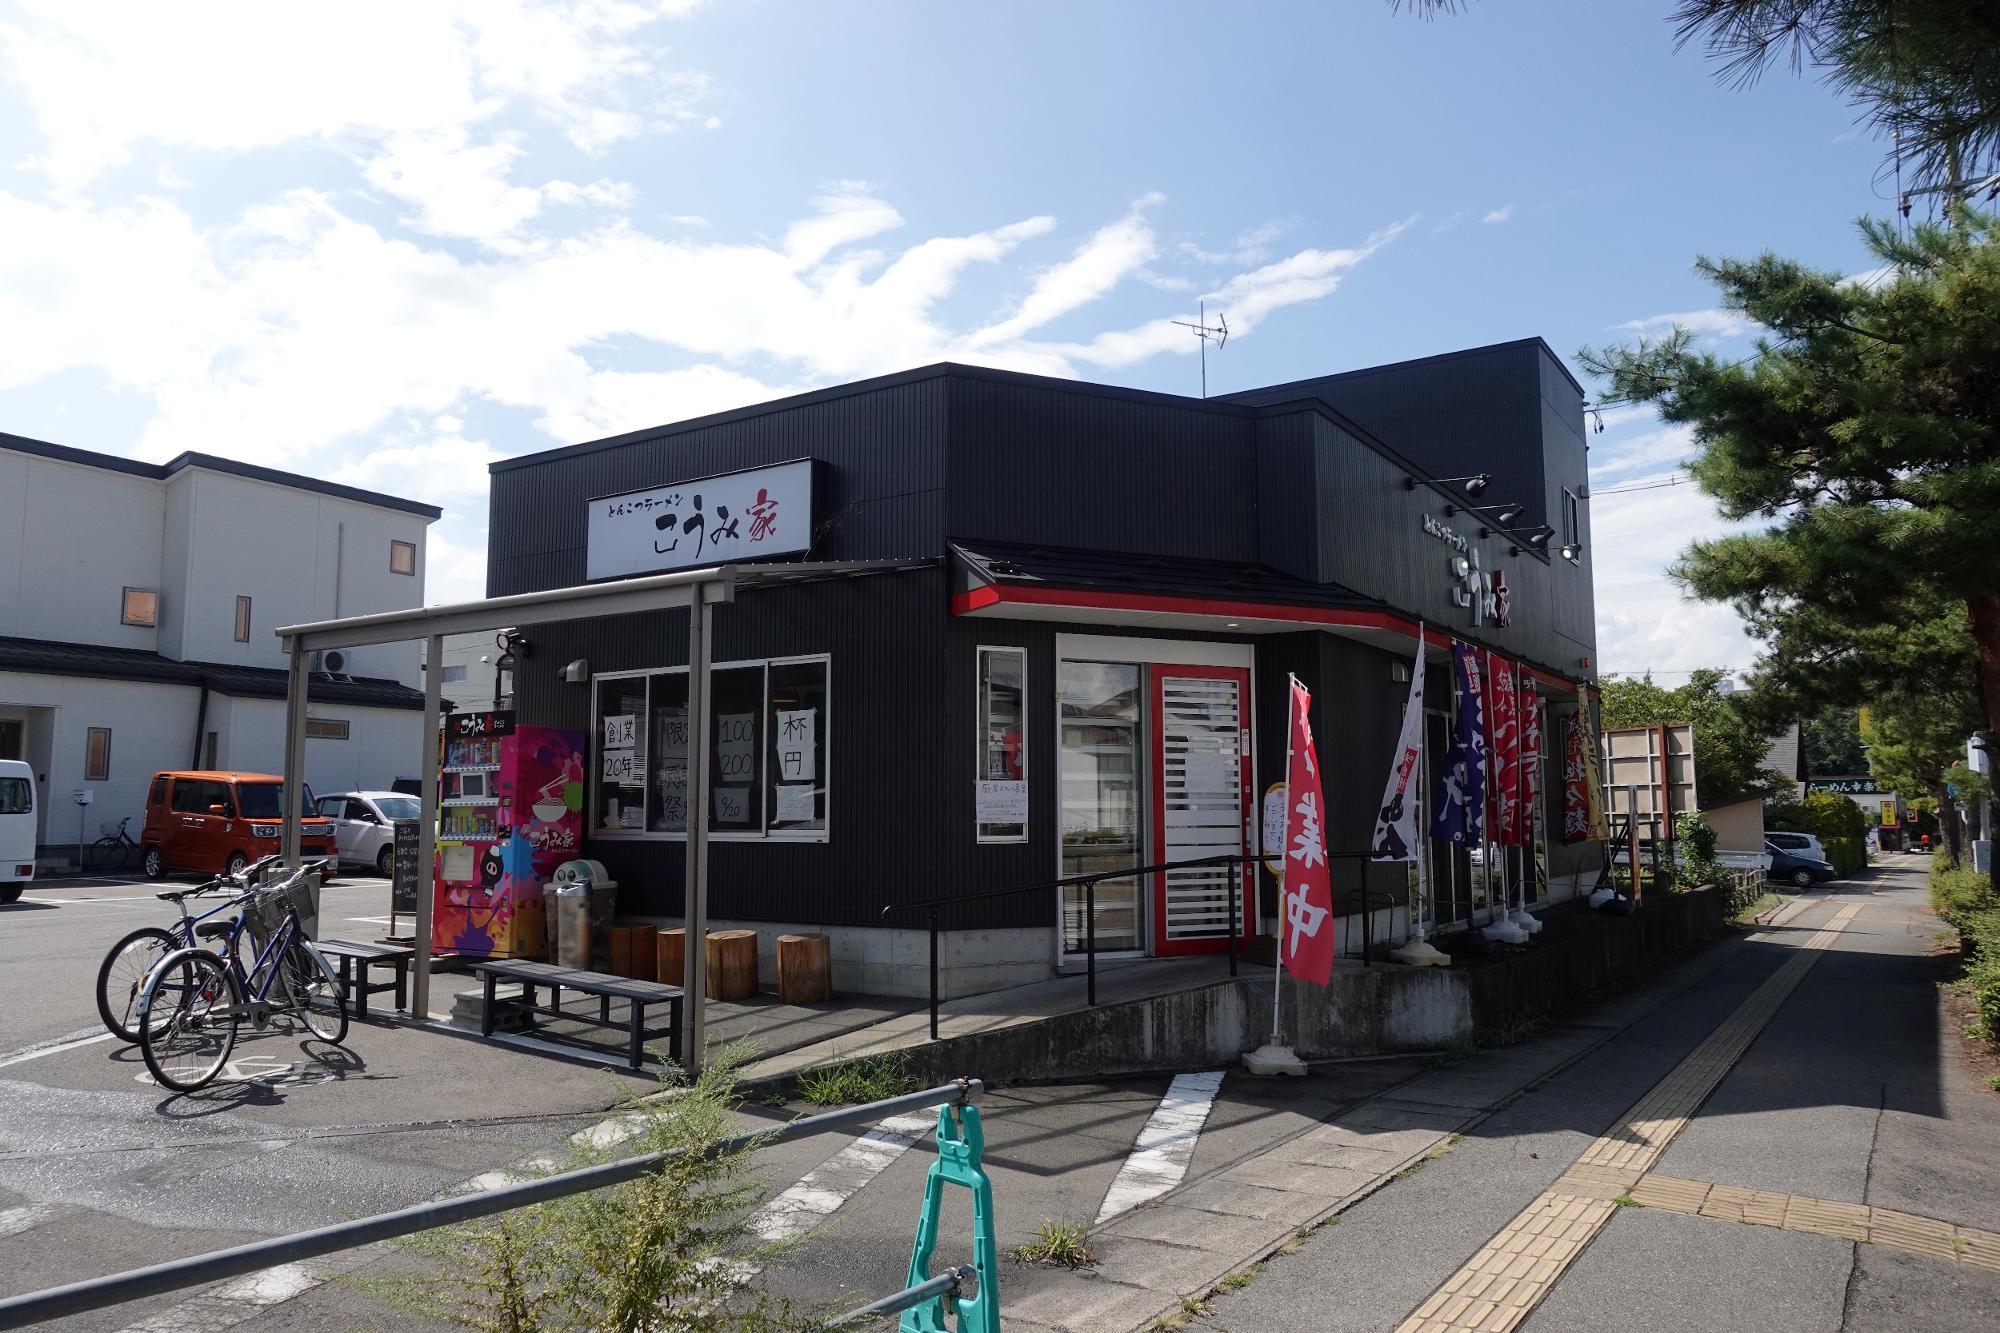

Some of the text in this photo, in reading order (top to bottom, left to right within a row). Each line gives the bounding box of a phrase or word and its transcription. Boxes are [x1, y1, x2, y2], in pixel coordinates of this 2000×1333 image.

[606, 719, 635, 743] 創業
[722, 720, 754, 744] 100
[784, 714, 807, 742] 杯
[721, 754, 754, 777] 200
[784, 751, 802, 776] 円
